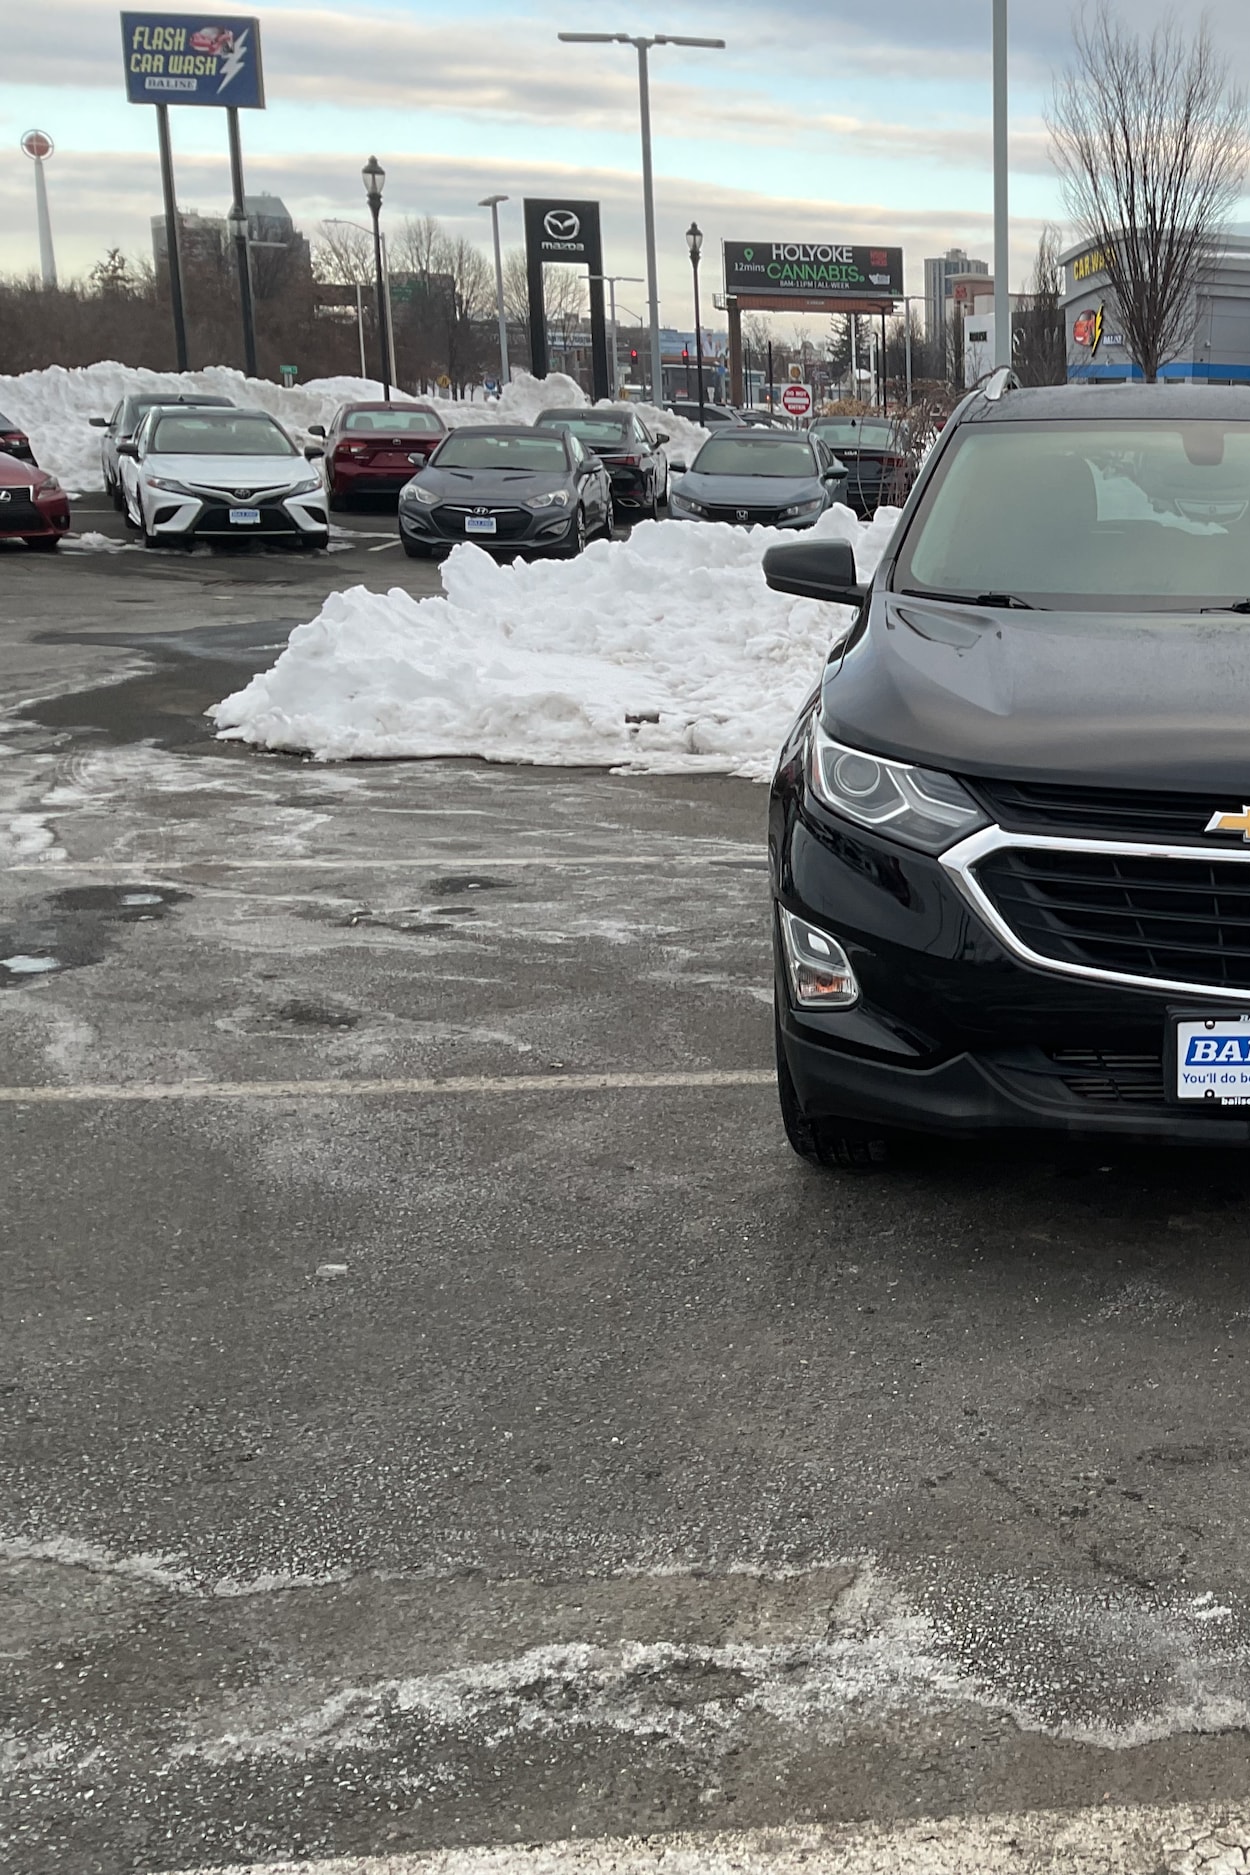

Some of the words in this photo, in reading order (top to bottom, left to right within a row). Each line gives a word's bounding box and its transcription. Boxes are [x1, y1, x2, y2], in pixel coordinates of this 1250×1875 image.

[132, 26, 186, 51] FLASH
[130, 53, 164, 73] CAR
[168, 55, 217, 75] WASH
[541, 241, 585, 251] mazda
[772, 243, 853, 263] HOLYOKE
[734, 262, 765, 273] 12mins
[767, 263, 860, 282] CANNABIS
[1073, 254, 1090, 281] CAR
[1183, 1073, 1216, 1083] You'll
[1220, 1073, 1236, 1083] do
